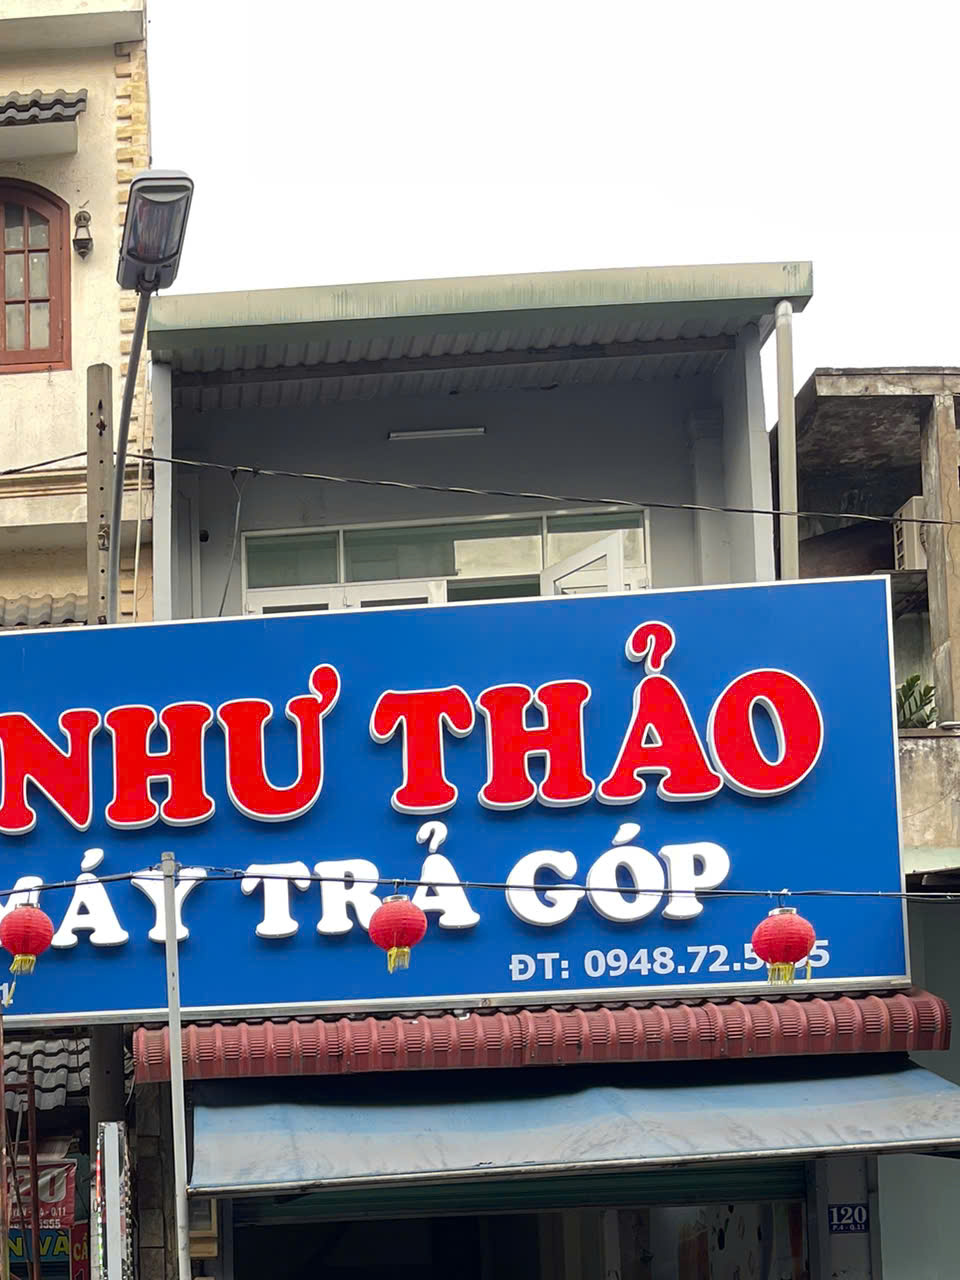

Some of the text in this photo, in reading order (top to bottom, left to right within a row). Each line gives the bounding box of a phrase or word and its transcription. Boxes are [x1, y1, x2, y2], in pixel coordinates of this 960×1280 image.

[370, 620, 825, 815] THẢO
[241, 821, 482, 939] TRẢ
[506, 822, 731, 927] GÓP
[509, 940, 830, 981] ĐT: 0948.72.55
[829, 1206, 867, 1225] 120
